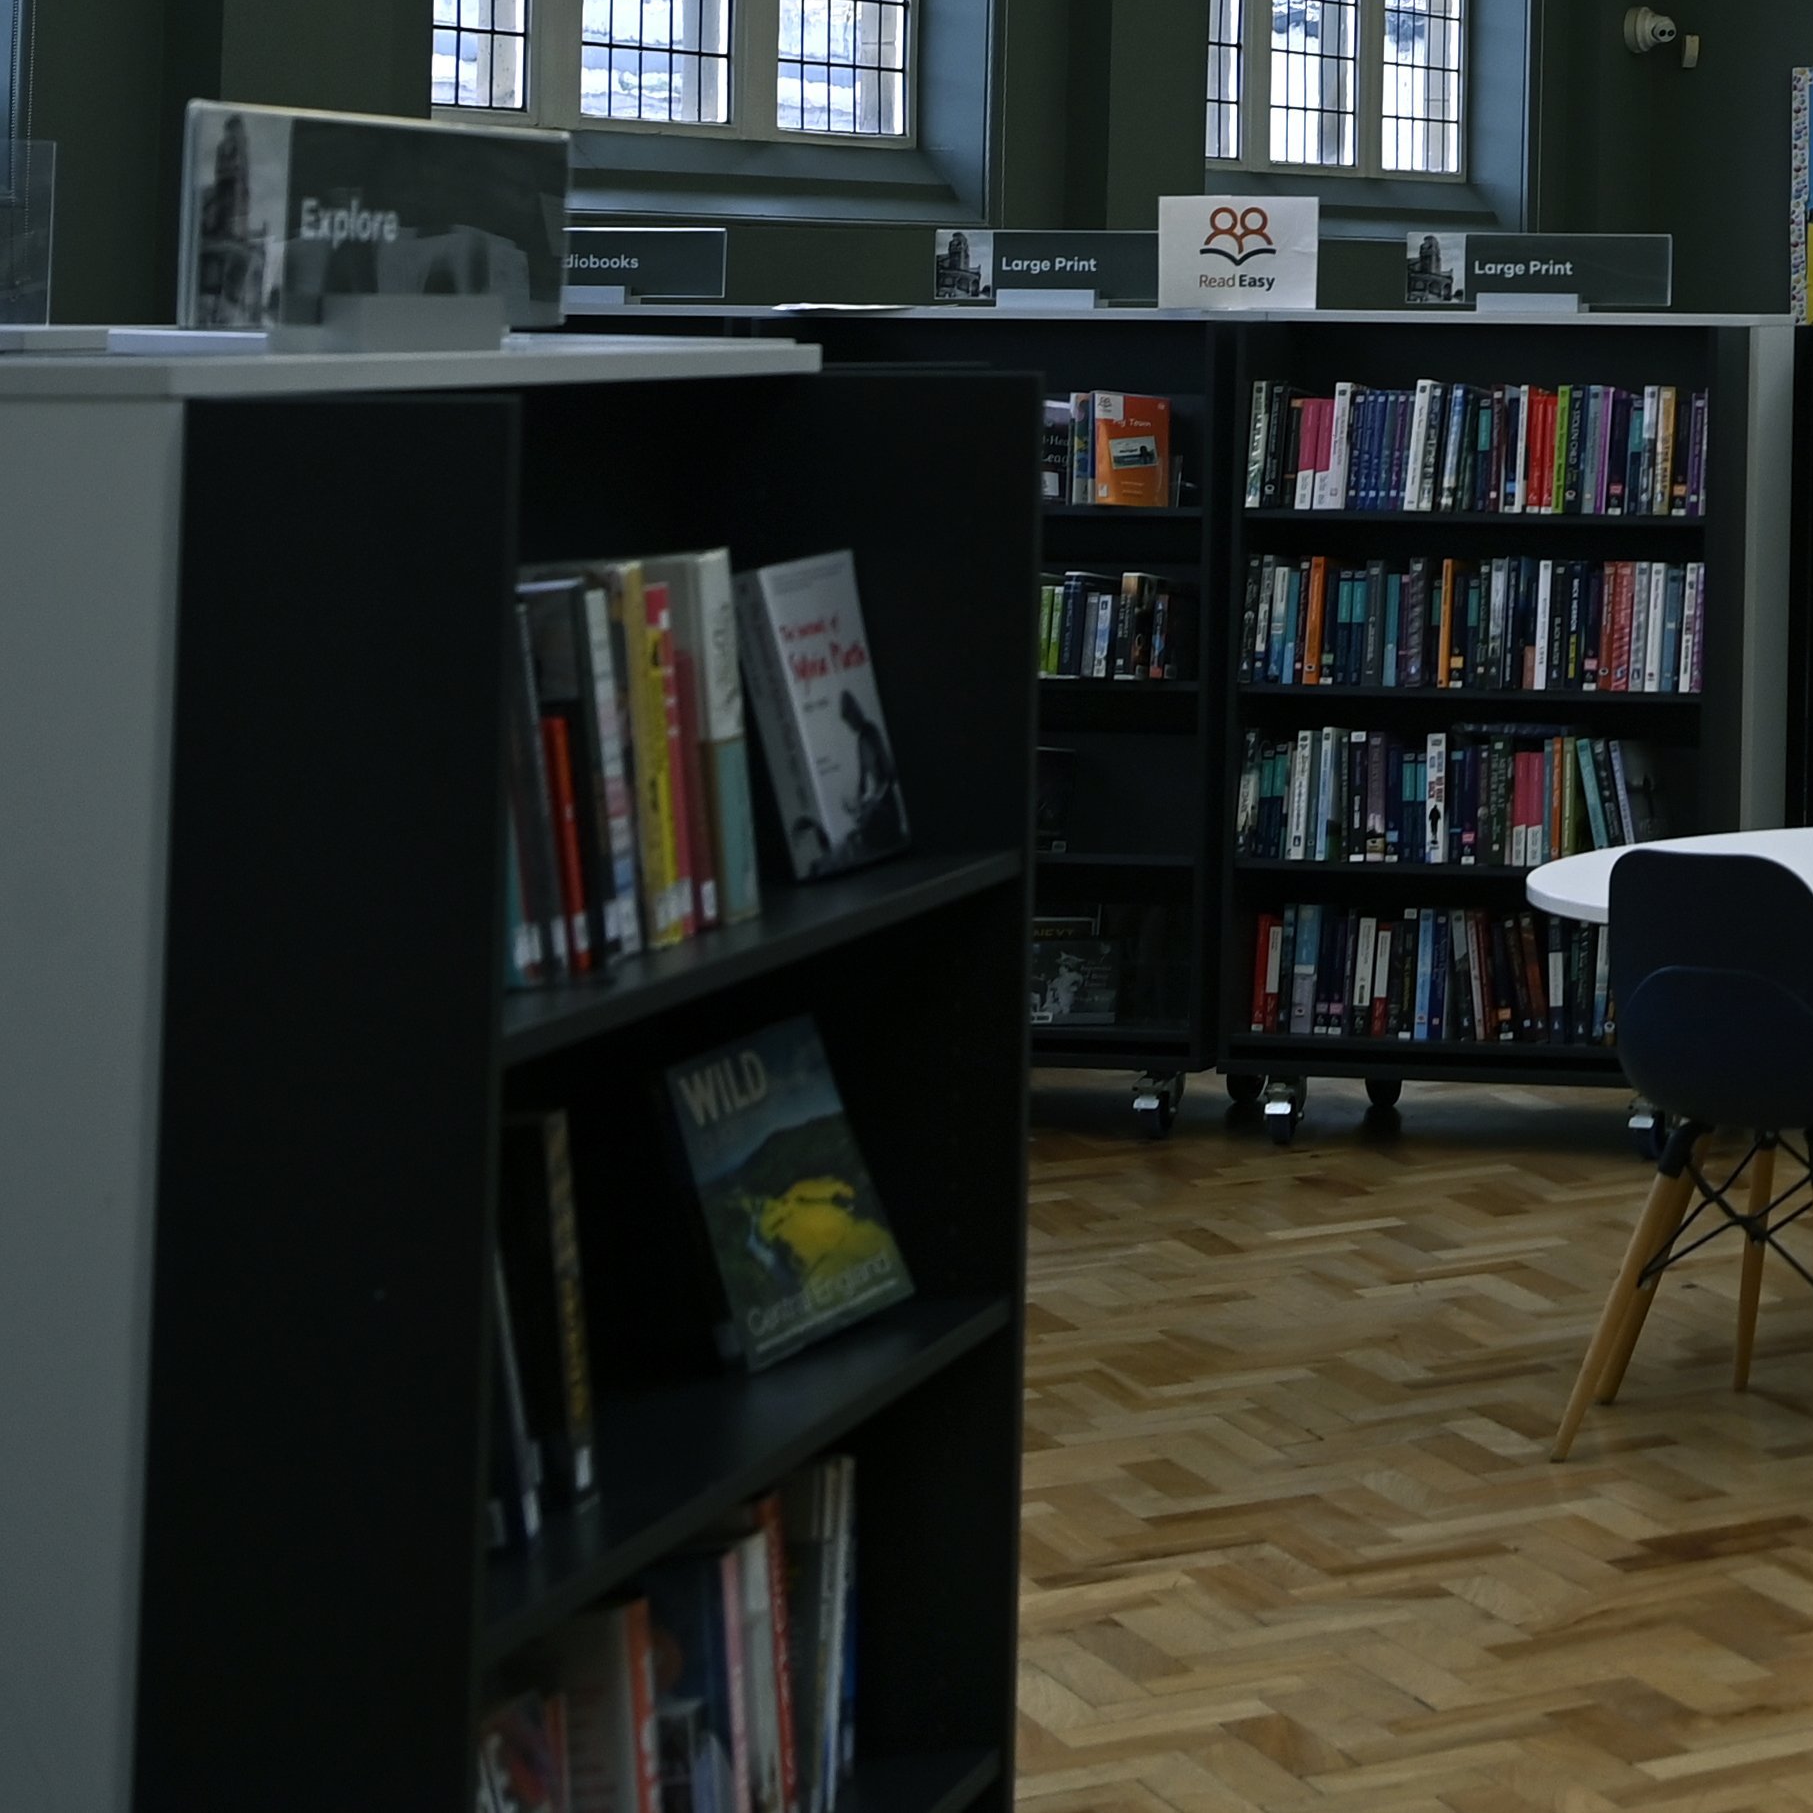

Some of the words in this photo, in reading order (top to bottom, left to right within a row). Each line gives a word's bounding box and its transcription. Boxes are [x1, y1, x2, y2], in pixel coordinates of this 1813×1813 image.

[300, 198, 398, 249] Explore
[1001, 257, 1051, 274] Large
[1055, 257, 1097, 272] Print
[1475, 259, 1521, 278] Large
[1527, 258, 1574, 275] Print
[1200, 274, 1236, 288] Read
[1238, 274, 1276, 292] Easy
[1130, 418, 1151, 428] Town
[679, 1049, 768, 1127] WILD
